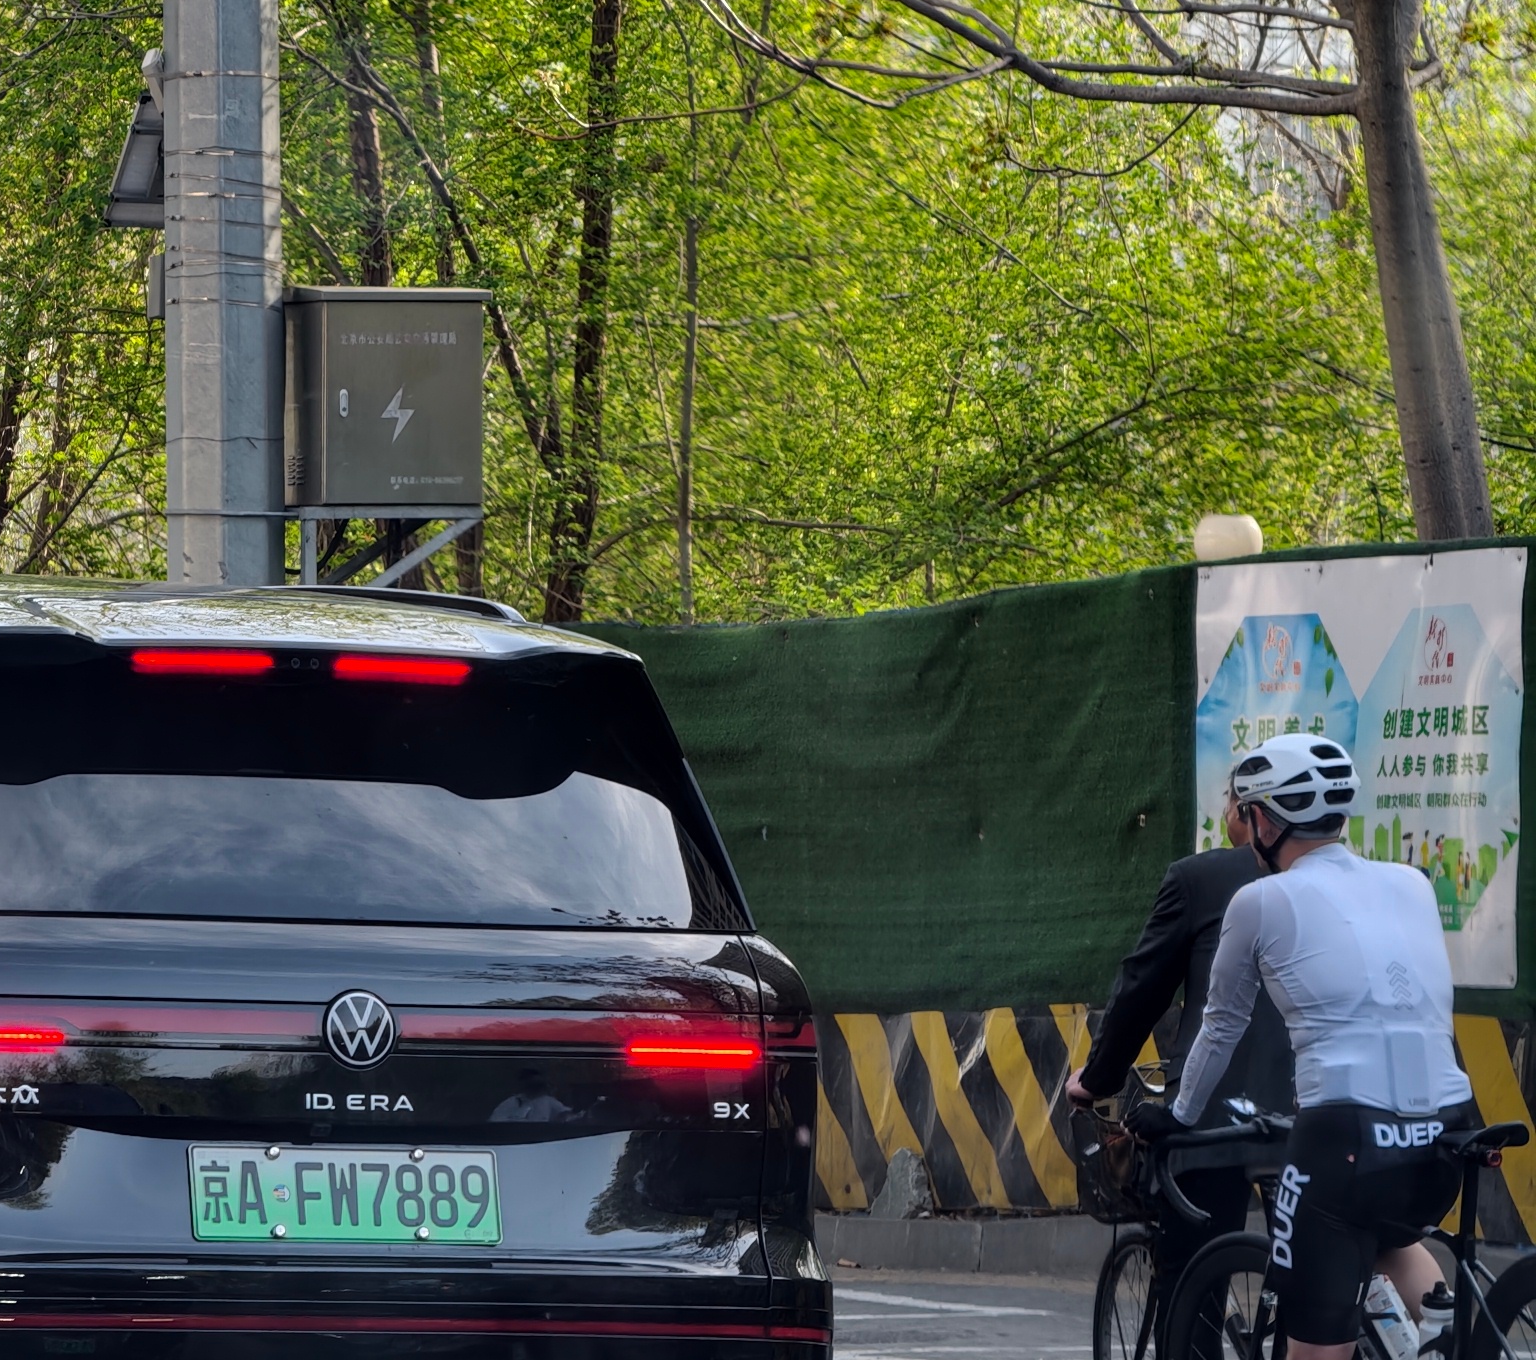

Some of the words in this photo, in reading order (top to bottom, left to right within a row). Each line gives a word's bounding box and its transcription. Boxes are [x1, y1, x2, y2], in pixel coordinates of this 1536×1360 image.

[1383, 705, 1489, 739] 创建文明城区
[1376, 754, 1426, 778] 人人参与
[1433, 753, 1489, 776] 你我共享
[1376, 793, 1422, 809] 创建文明城区
[305, 1093, 336, 1110] ID.
[346, 1094, 414, 1111] ERA
[713, 1102, 751, 1119] 9X
[1374, 1121, 1444, 1148] DUER
[1272, 1164, 1310, 1269] DUER
